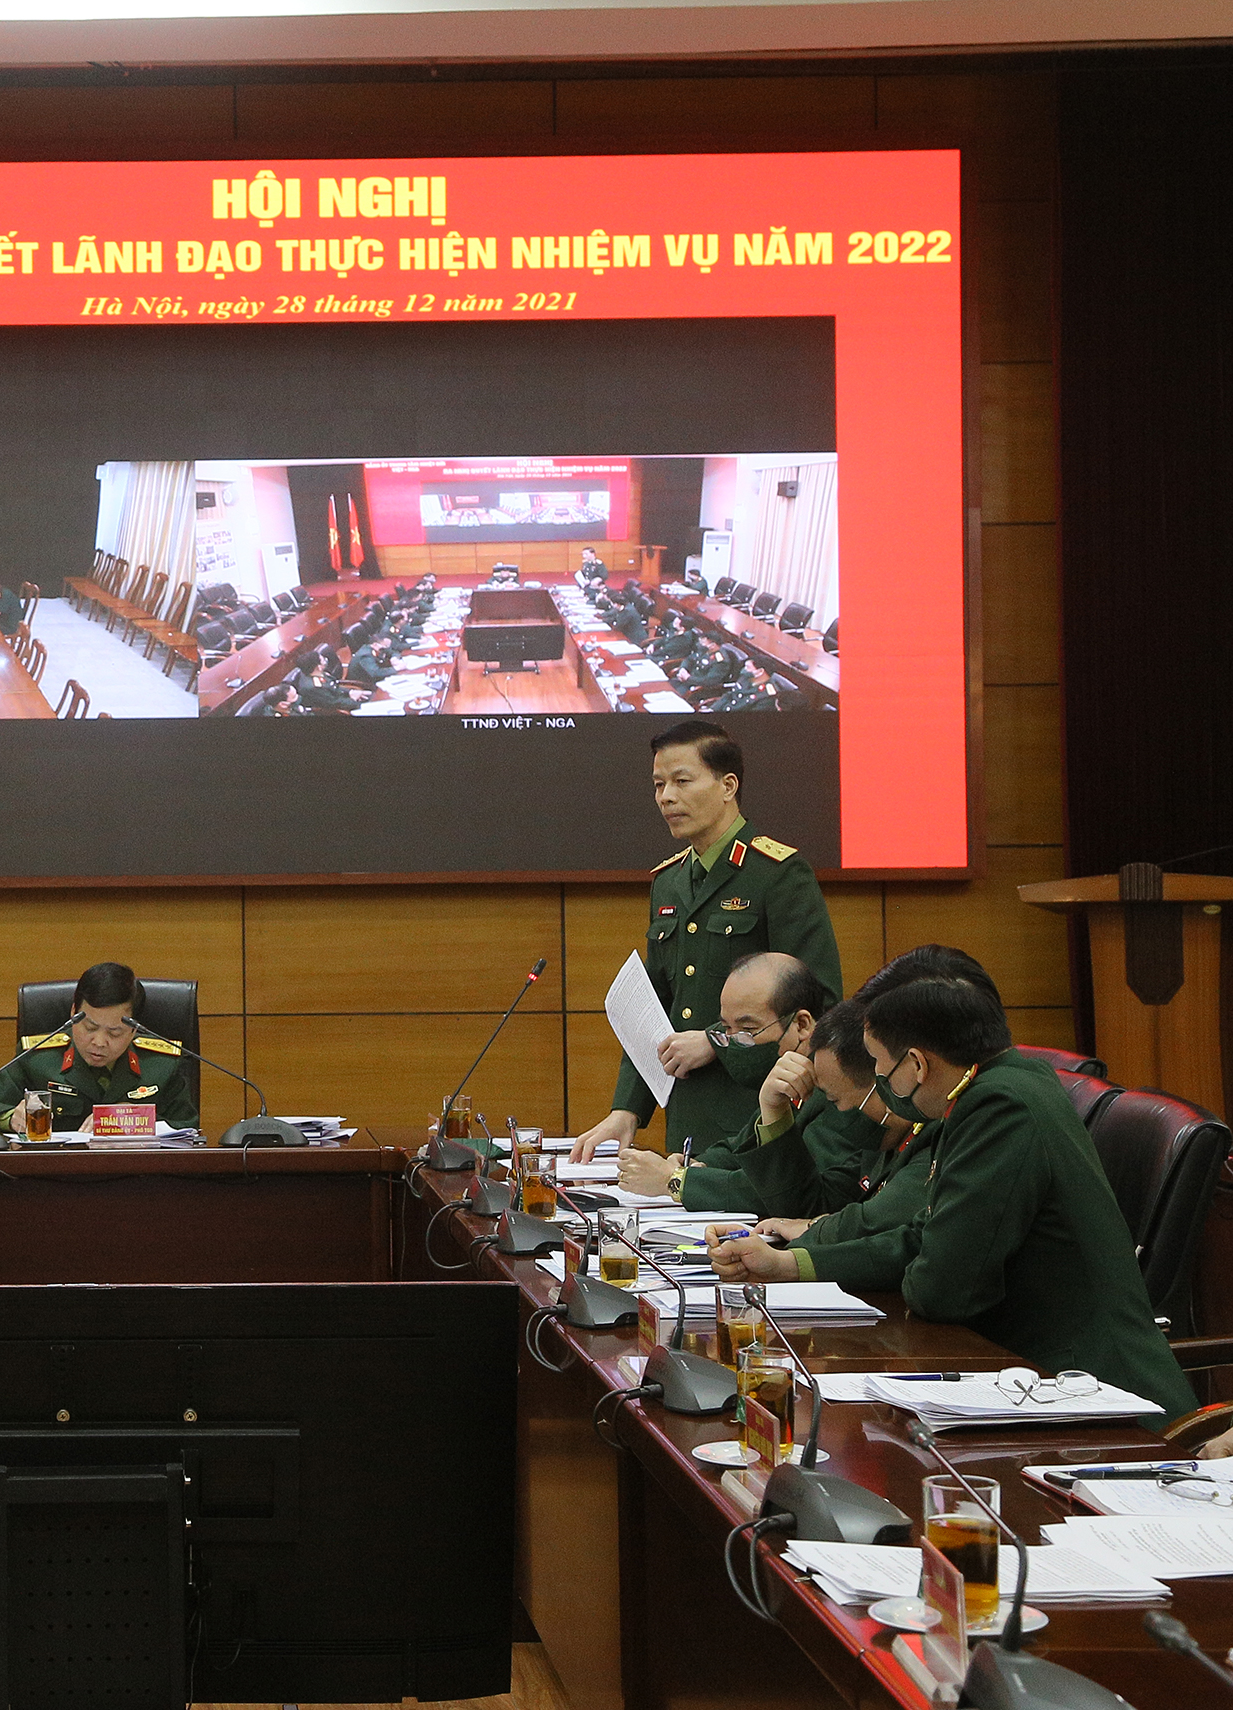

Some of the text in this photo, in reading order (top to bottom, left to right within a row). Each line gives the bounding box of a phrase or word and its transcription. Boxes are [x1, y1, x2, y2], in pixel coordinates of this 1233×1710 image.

[212, 169, 447, 228] HỘI NGHỊ
[52, 235, 163, 274] LÃNH
[175, 239, 262, 280] ĐẠO
[275, 235, 385, 279] THỰC
[399, 230, 497, 277] HIỆN
[511, 228, 651, 276] NHIỆM
[664, 234, 719, 274] VỤ
[733, 226, 833, 267] NĂM
[847, 230, 952, 265] 2022
[80, 292, 578, 320] Hà Nội, ngày 28 tháng 12 năm 2021
[461, 718, 499, 728] TTNĐ
[502, 715, 532, 730] VIỆT
[545, 718, 575, 728] NGA
[135, 1116, 149, 1126] DUY
